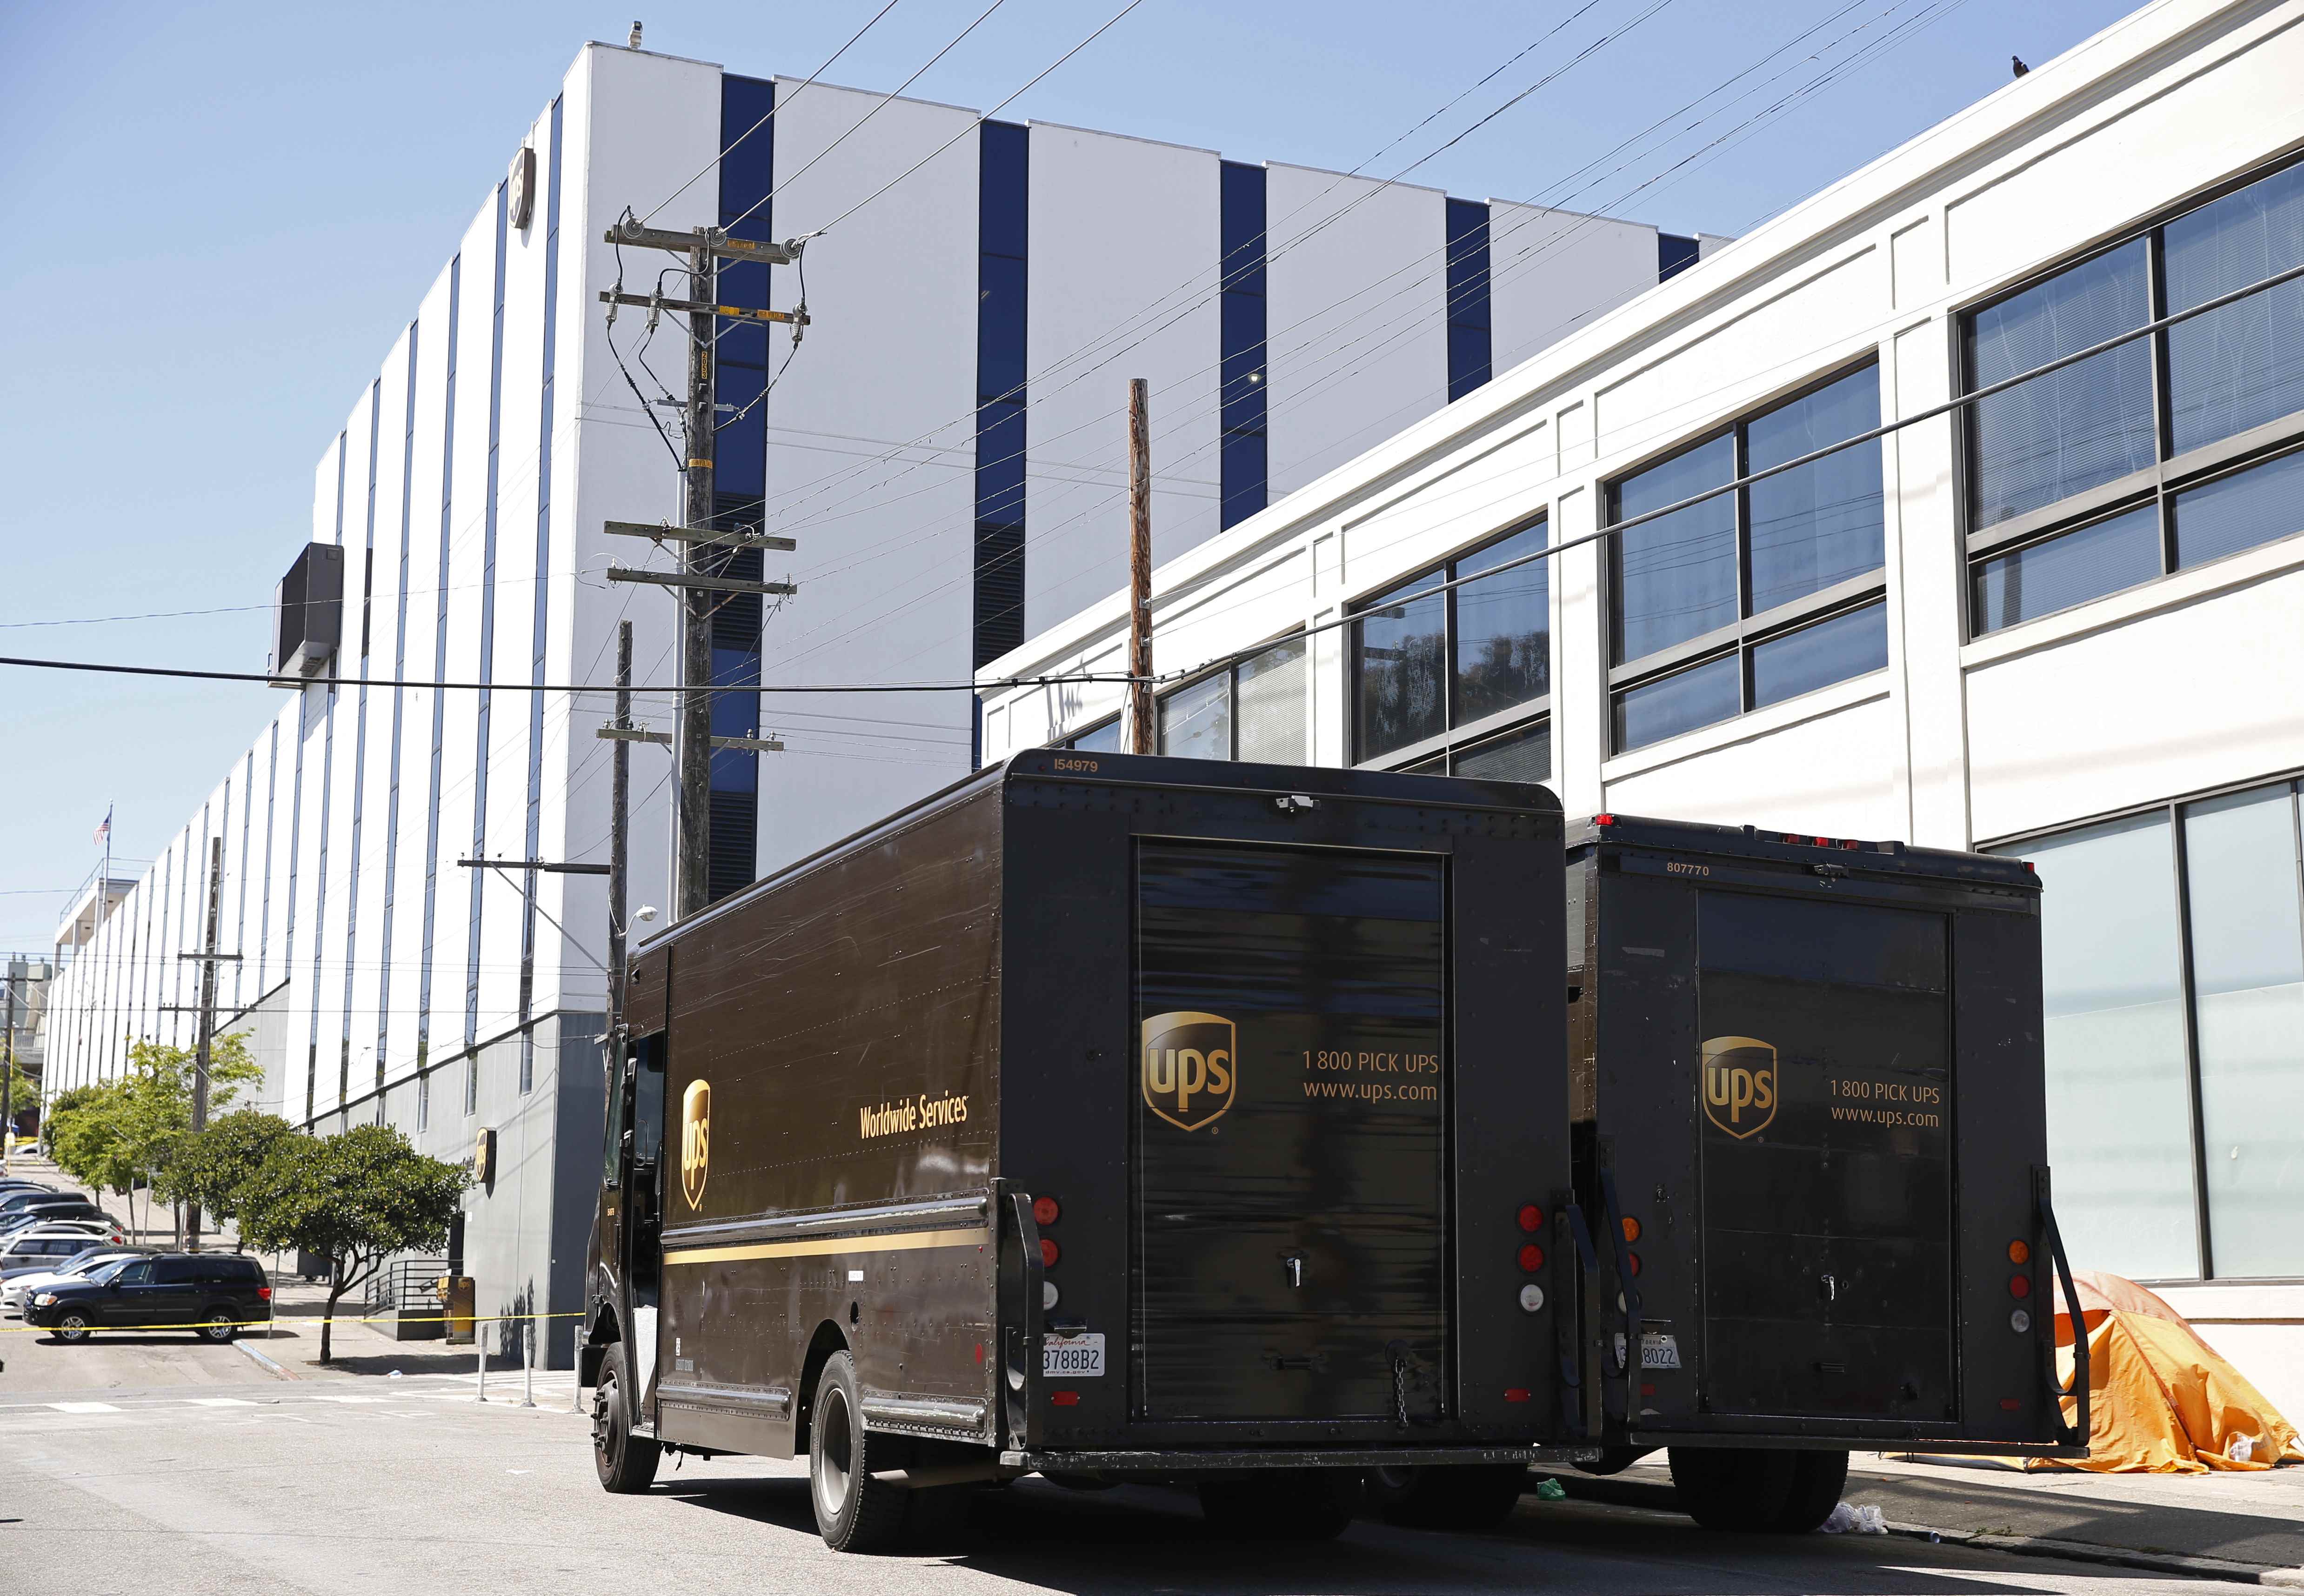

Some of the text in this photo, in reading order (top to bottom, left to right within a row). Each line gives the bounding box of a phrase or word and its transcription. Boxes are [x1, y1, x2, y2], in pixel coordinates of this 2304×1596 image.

[1667, 862, 1709, 876] 807770
[1303, 1050, 1438, 1073] 1 800 PICK UPS
[1149, 1048, 1230, 1112] ups
[1830, 1079, 1939, 1104] 1 800 PICK UPS
[1303, 1083, 1437, 1104] www.ups.com
[1708, 1067, 1772, 1123] ups
[860, 1090, 968, 1139] Worldwide Services
[1831, 1107, 1938, 1128] www.ups.com
[684, 1118, 708, 1190] ups
